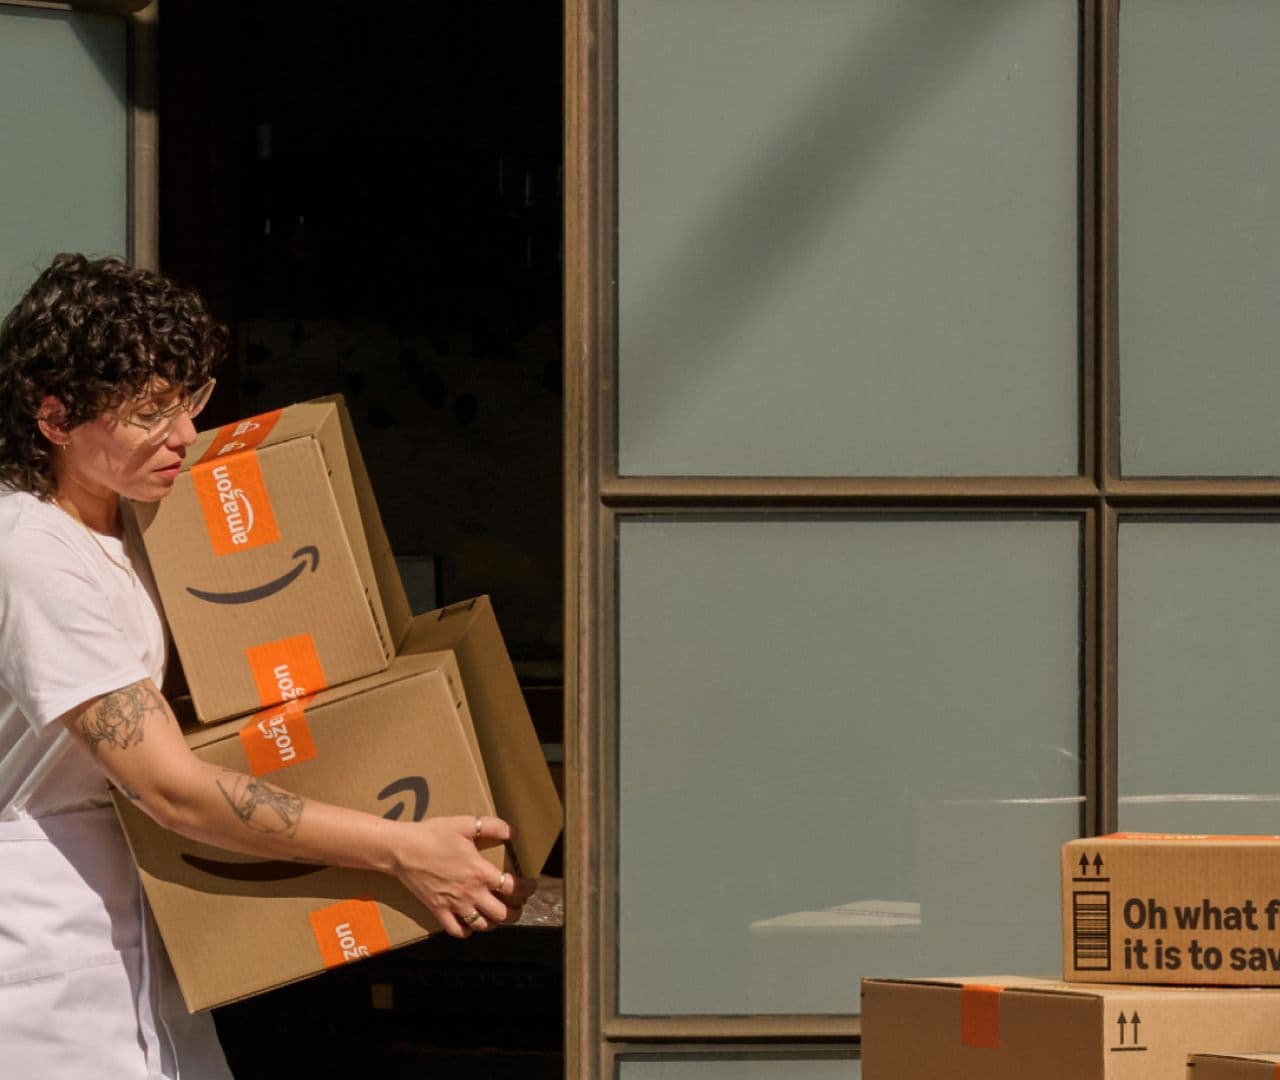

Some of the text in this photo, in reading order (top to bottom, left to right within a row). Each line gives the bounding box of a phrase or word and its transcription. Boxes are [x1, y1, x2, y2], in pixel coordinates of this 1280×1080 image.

[212, 465, 250, 544] amazon
[274, 664, 300, 701] zon
[269, 713, 296, 761] azon
[1123, 897, 1168, 931] Oh
[1173, 899, 1260, 932] what
[335, 922, 360, 961] zon
[1123, 938, 1150, 971] it
[1154, 938, 1182, 971] is
[1187, 940, 1223, 972] to
